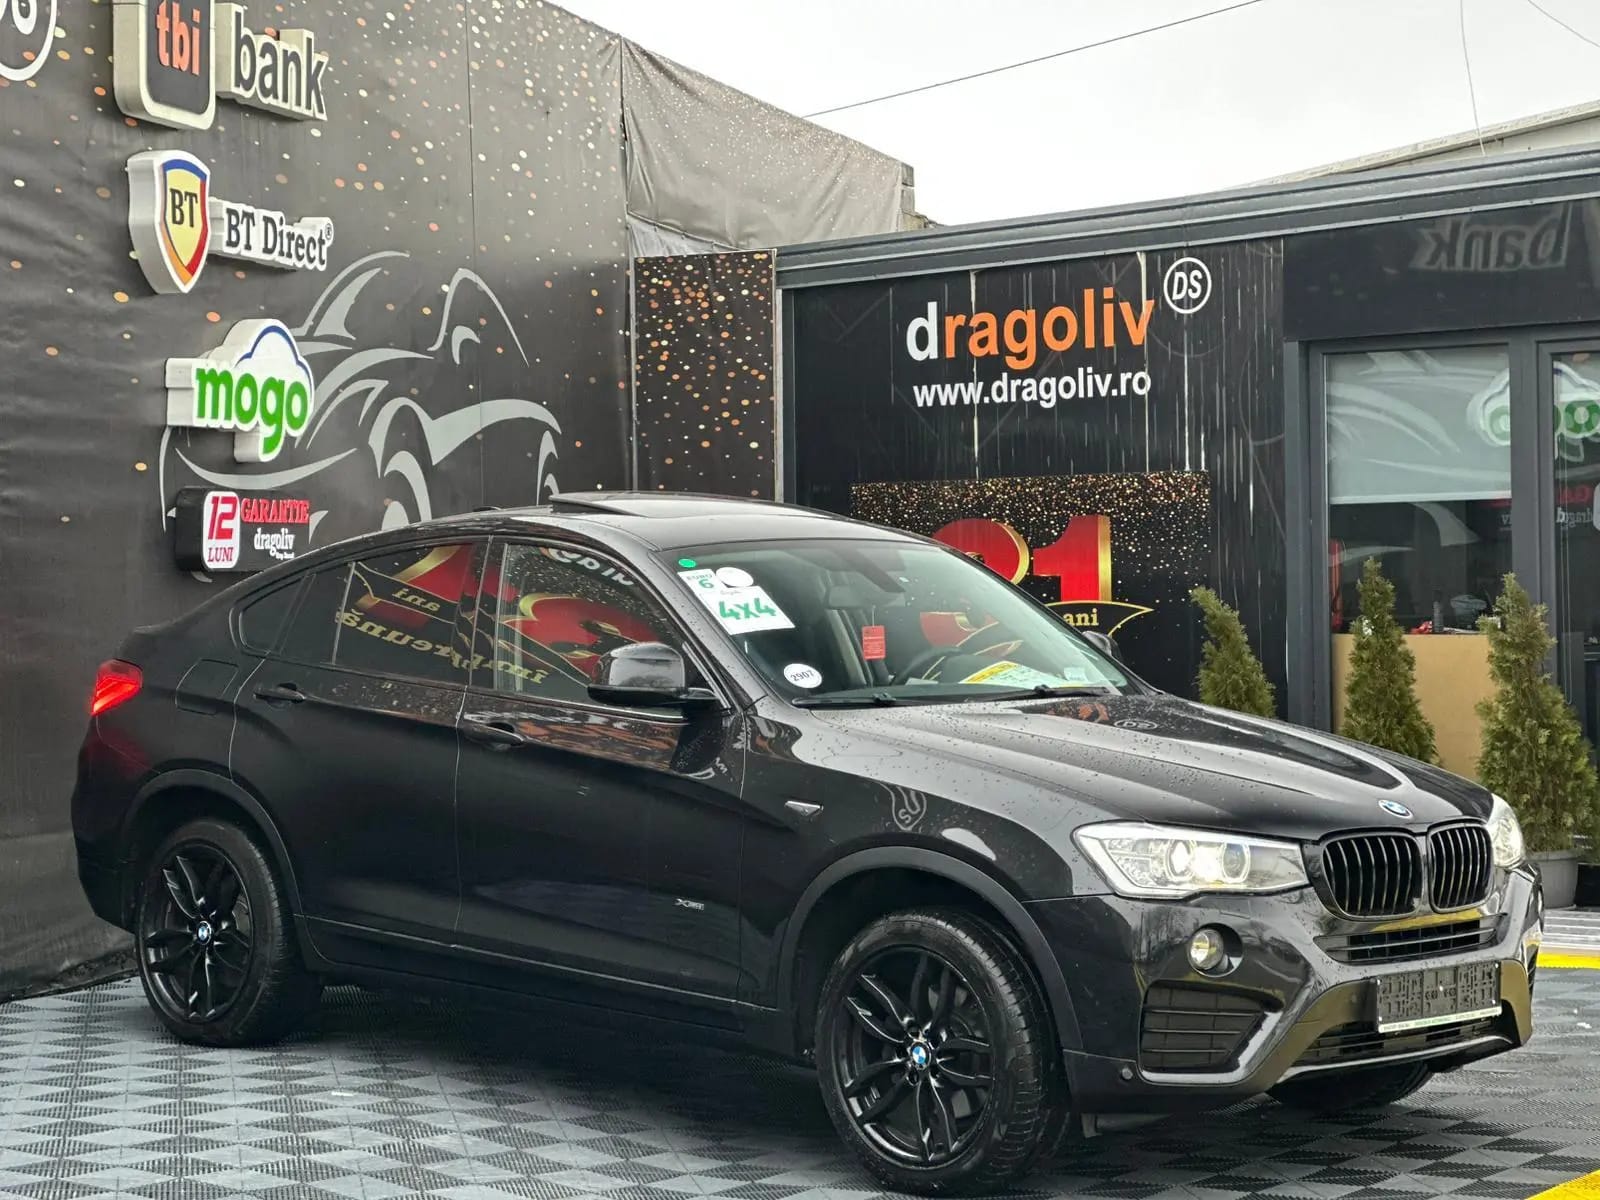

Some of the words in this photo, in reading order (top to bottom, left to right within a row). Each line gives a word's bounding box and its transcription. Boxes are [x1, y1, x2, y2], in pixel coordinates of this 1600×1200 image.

[156, 1, 200, 76] tbi
[234, 11, 326, 116] bank
[169, 188, 199, 228] BT
[226, 208, 256, 251] BT
[1172, 269, 1203, 301] DS
[906, 286, 1155, 371] dragoliv
[912, 366, 1152, 409] www.dragoliv.ro
[195, 367, 308, 455] mogo
[207, 495, 238, 540] 12
[240, 497, 310, 524] GARANTIE
[207, 547, 234, 562] LUNI
[253, 527, 295, 557] dragoliv
